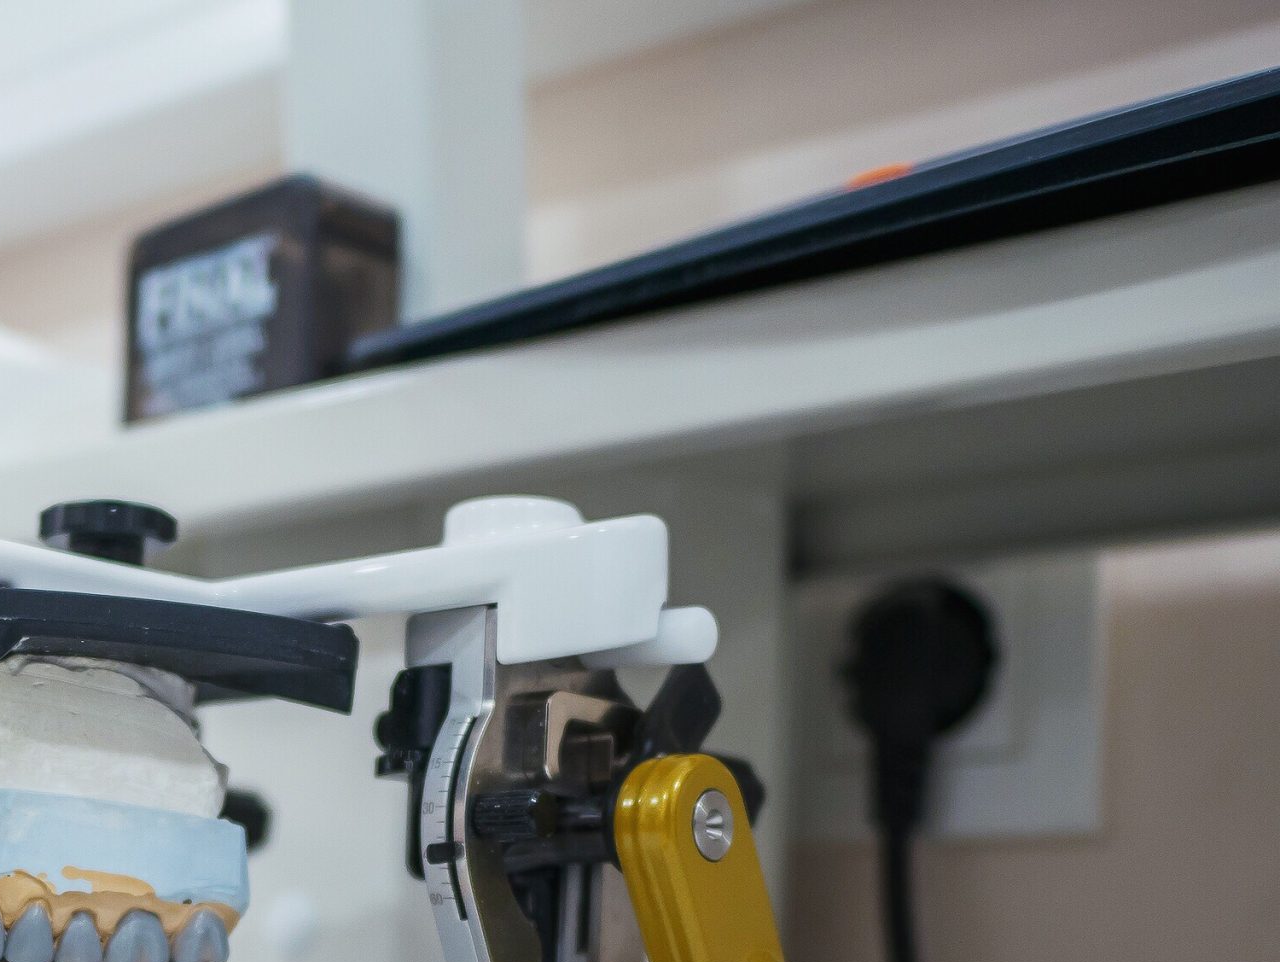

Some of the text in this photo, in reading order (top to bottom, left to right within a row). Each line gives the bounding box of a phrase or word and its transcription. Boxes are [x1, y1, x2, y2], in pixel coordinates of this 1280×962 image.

[430, 757, 442, 769] 15
[422, 801, 435, 815] 30
[429, 892, 444, 906] 60
